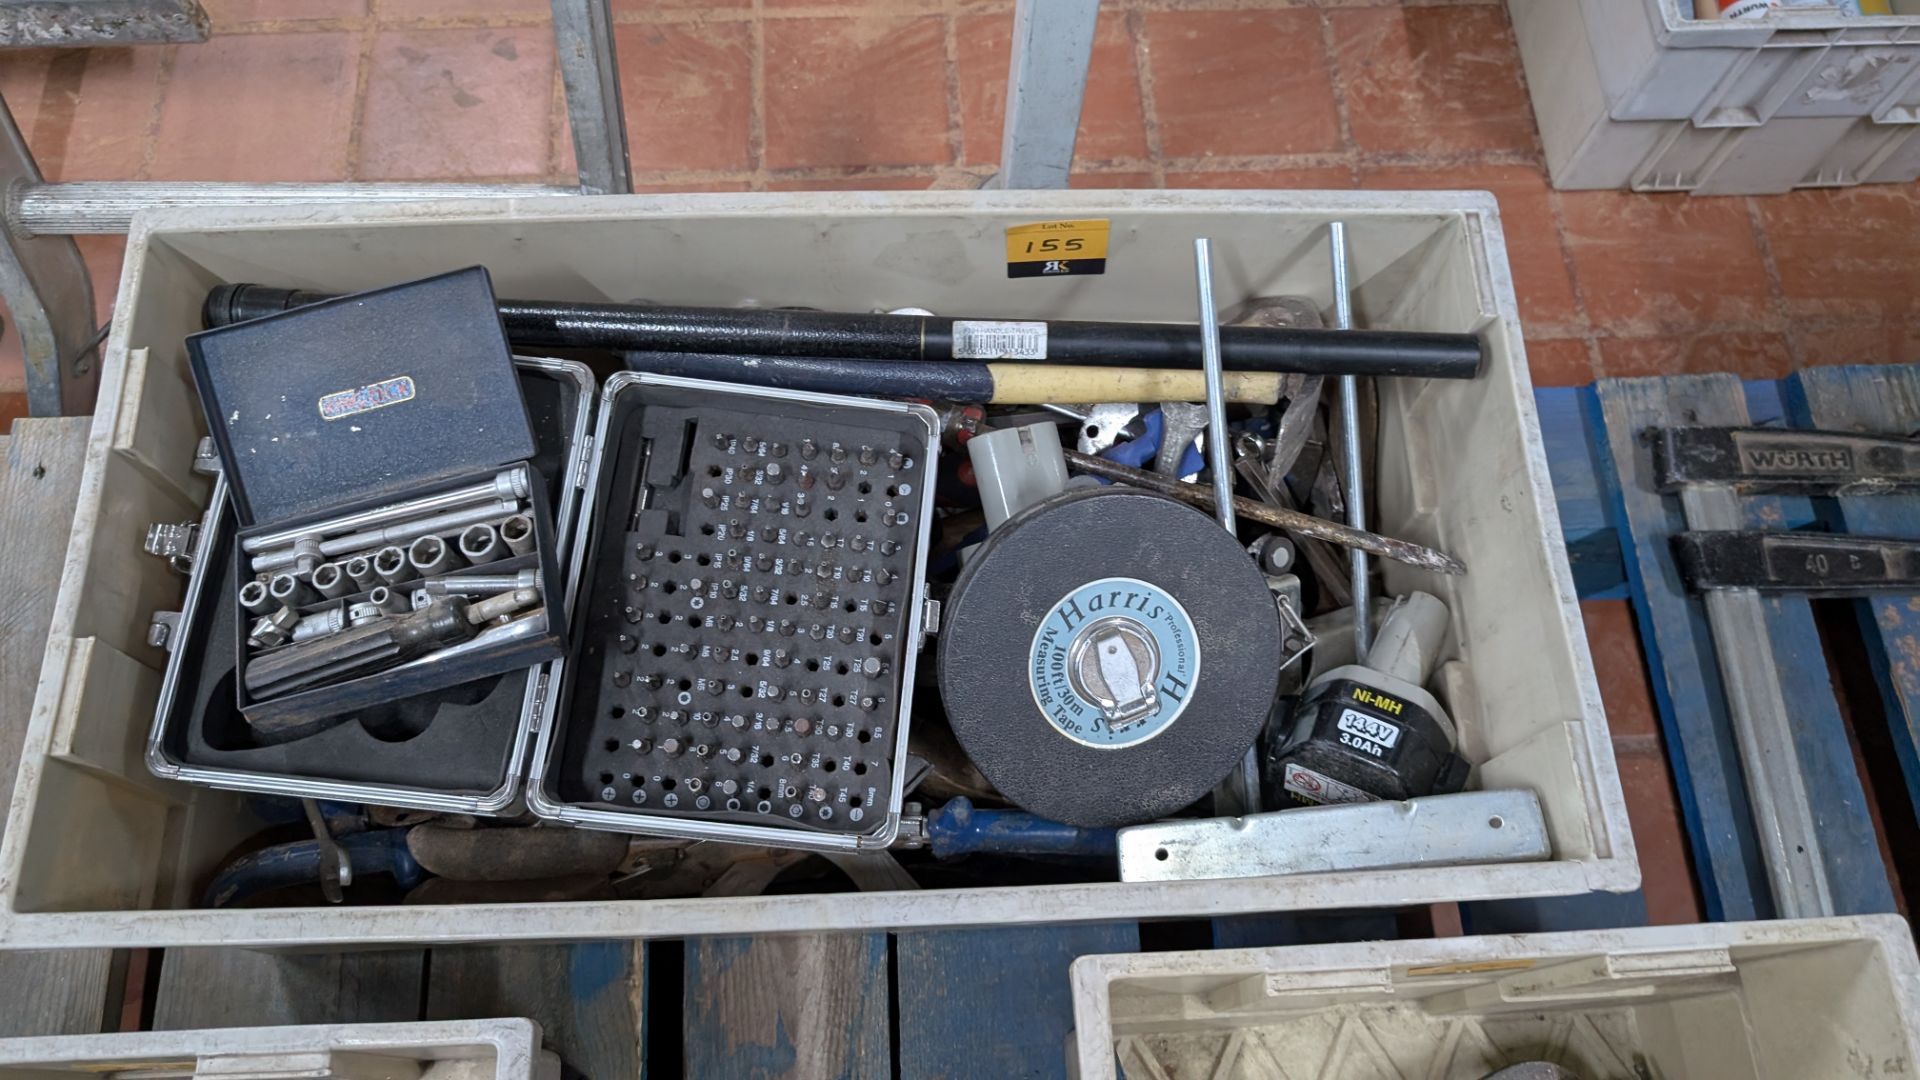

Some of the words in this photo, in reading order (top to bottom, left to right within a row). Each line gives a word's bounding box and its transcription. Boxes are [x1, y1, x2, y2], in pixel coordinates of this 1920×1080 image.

[1025, 238, 1085, 254] 155
[1748, 448, 1849, 468] WÜRTH
[830, 595, 839, 609] T15
[1057, 591, 1164, 632] Harris
[856, 627, 865, 642] T20
[853, 658, 862, 673] T25
[1036, 626, 1058, 707] Measuring
[1052, 704, 1083, 734] Tape
[1051, 644, 1084, 717] 100ft/30m
[819, 687, 828, 703] T27
[849, 690, 859, 705] T27
[1352, 687, 1404, 715] Ni-MH
[815, 719, 825, 735] T30
[1345, 713, 1394, 741] 14.4V
[1339, 731, 1383, 757] 3.0Ah
[750, 745, 759, 763] 7/32
[842, 755, 851, 770] T40
[746, 781, 755, 793] 1/4
[778, 778, 787, 798] 8mm
[838, 787, 848, 803] T45
